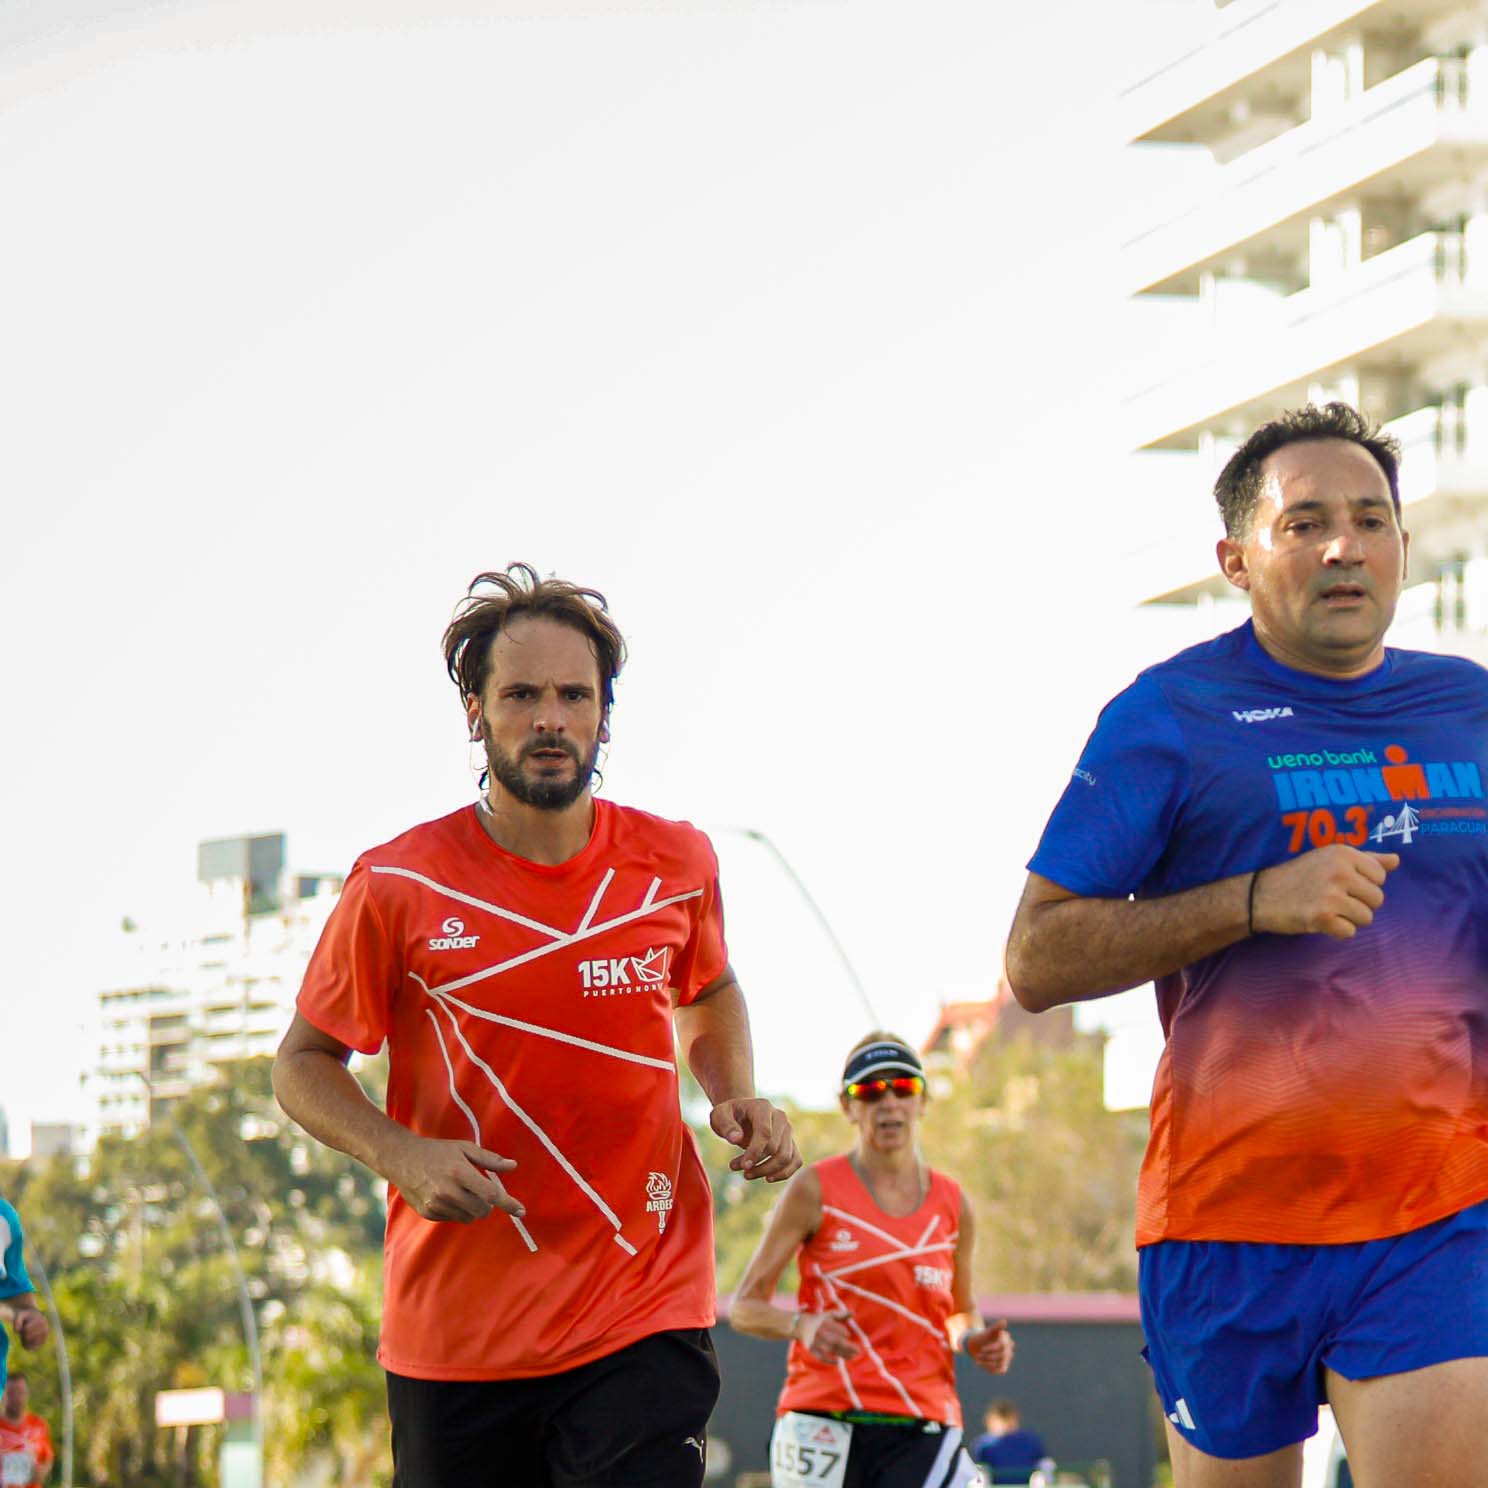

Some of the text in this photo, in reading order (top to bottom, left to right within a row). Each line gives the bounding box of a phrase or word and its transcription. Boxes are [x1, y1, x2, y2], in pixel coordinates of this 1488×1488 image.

[1233, 707, 1294, 722] HOKA
[1268, 748, 1377, 768] ueno bank
[1274, 744, 1483, 811] IRONMAN
[1282, 806, 1369, 853] 70.3
[578, 957, 631, 988] 15K
[583, 986, 632, 998] PUERTO
[775, 1440, 841, 1479] 1557
